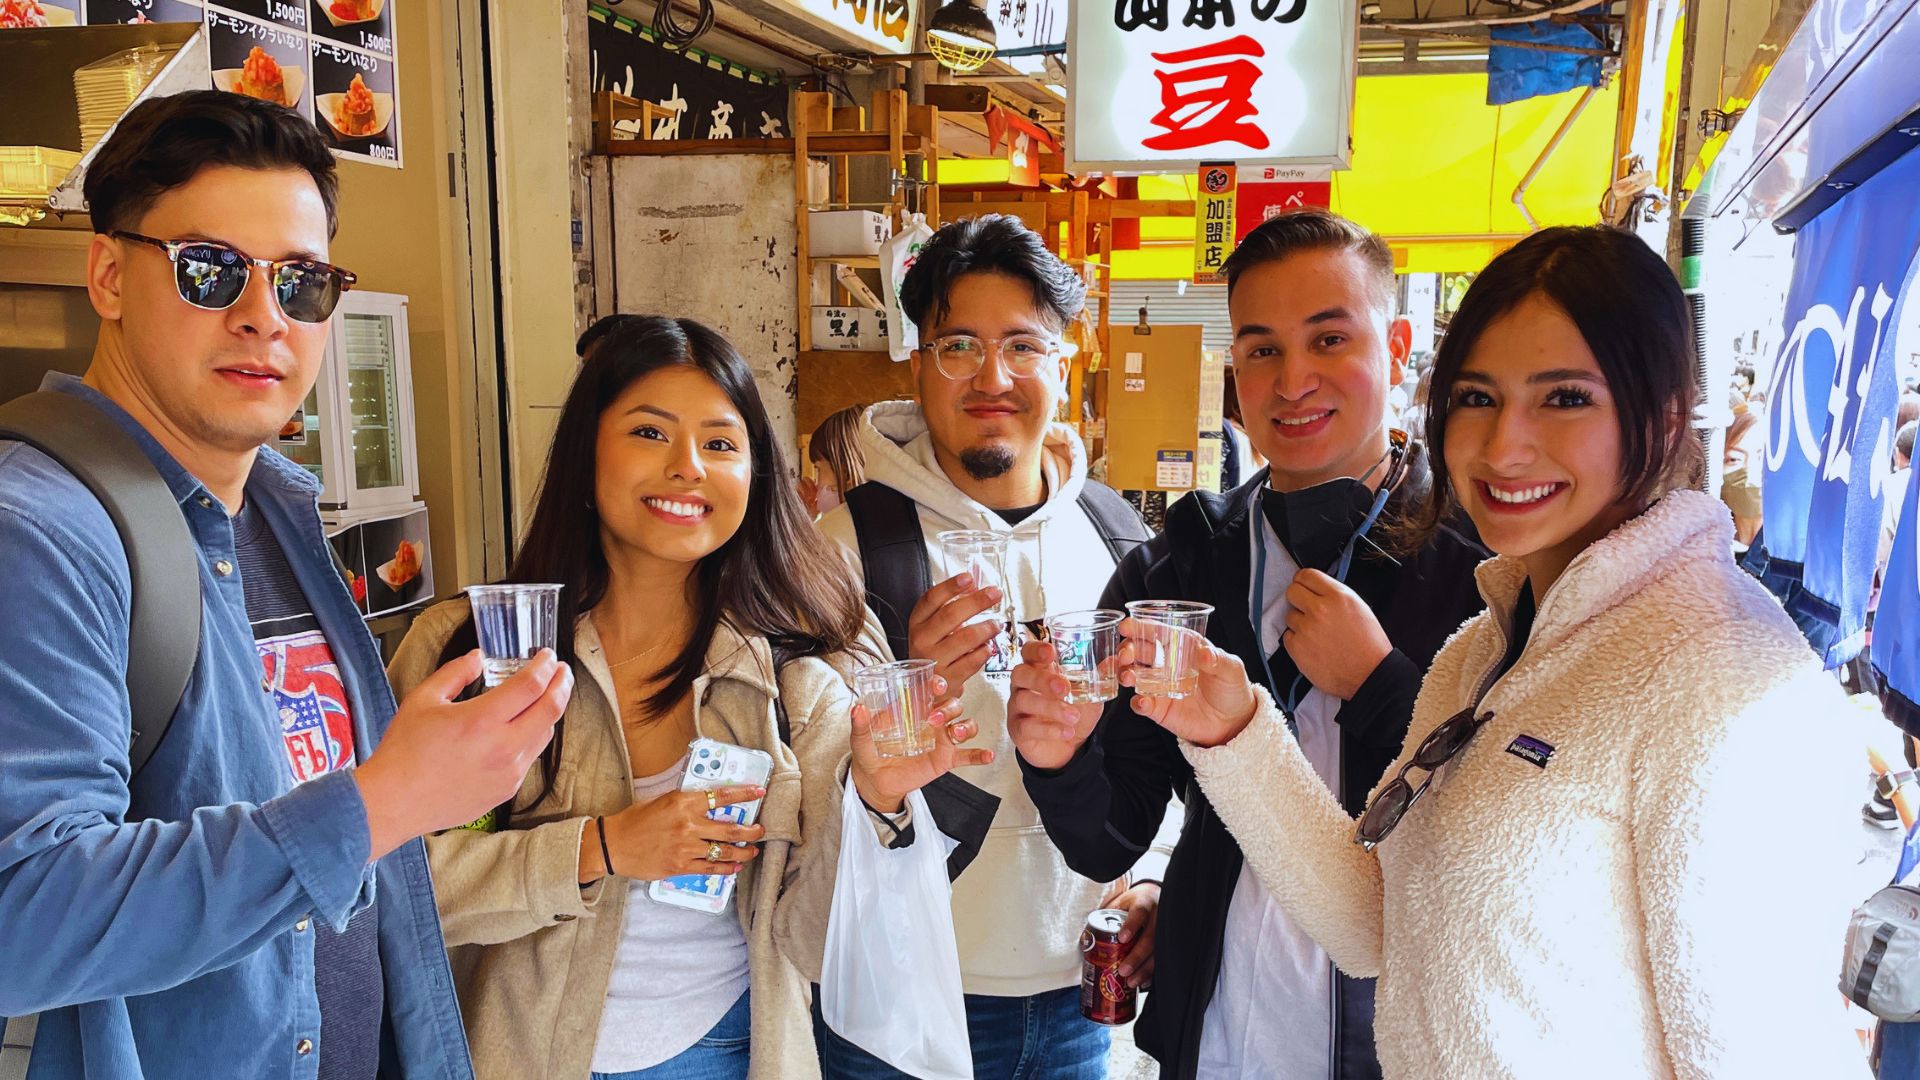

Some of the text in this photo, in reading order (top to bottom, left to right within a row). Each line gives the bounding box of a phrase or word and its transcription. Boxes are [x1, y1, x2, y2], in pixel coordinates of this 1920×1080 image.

[266, 0, 305, 26] 1,500円
[208, 11, 304, 50] サーモンイクラいなり
[359, 31, 392, 54] 1,500円
[311, 40, 378, 73] サーモンいなり
[1141, 34, 1270, 150] 豆
[369, 143, 396, 160] 800円
[1275, 169, 1306, 177] PayPay
[1205, 198, 1225, 267] 加盟店
[1509, 742, 1542, 762] patagonia
